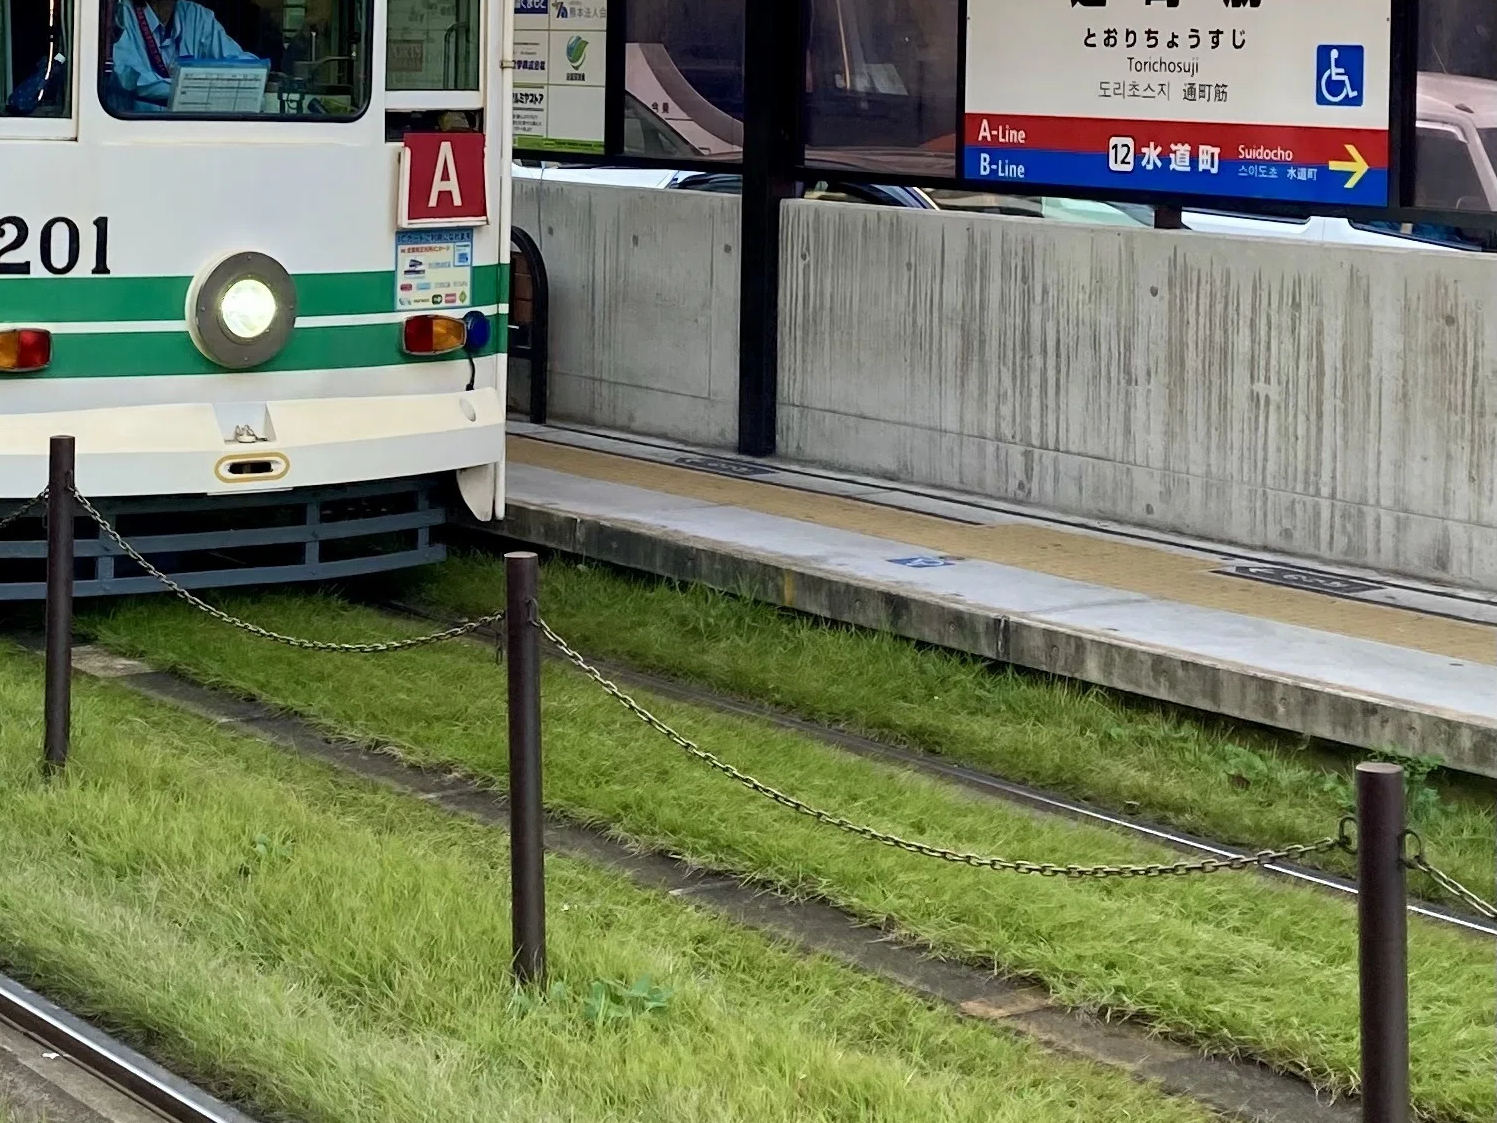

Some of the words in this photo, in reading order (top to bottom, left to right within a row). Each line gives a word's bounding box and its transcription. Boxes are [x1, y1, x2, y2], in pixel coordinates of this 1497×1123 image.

[1083, 27, 1246, 50] とおりちょうすじ
[1126, 56, 1200, 78] Torichosuji
[1098, 80, 1171, 101] 도리초스지
[1182, 82, 1229, 103] 通町筋
[978, 118, 1027, 144] A-Line
[1111, 143, 1131, 166] 12
[1141, 141, 1221, 174] 水道町
[1238, 144, 1293, 162] Suidocho
[428, 140, 463, 208] A
[979, 152, 1026, 179] B-Line
[1286, 167, 1318, 182] 水道町
